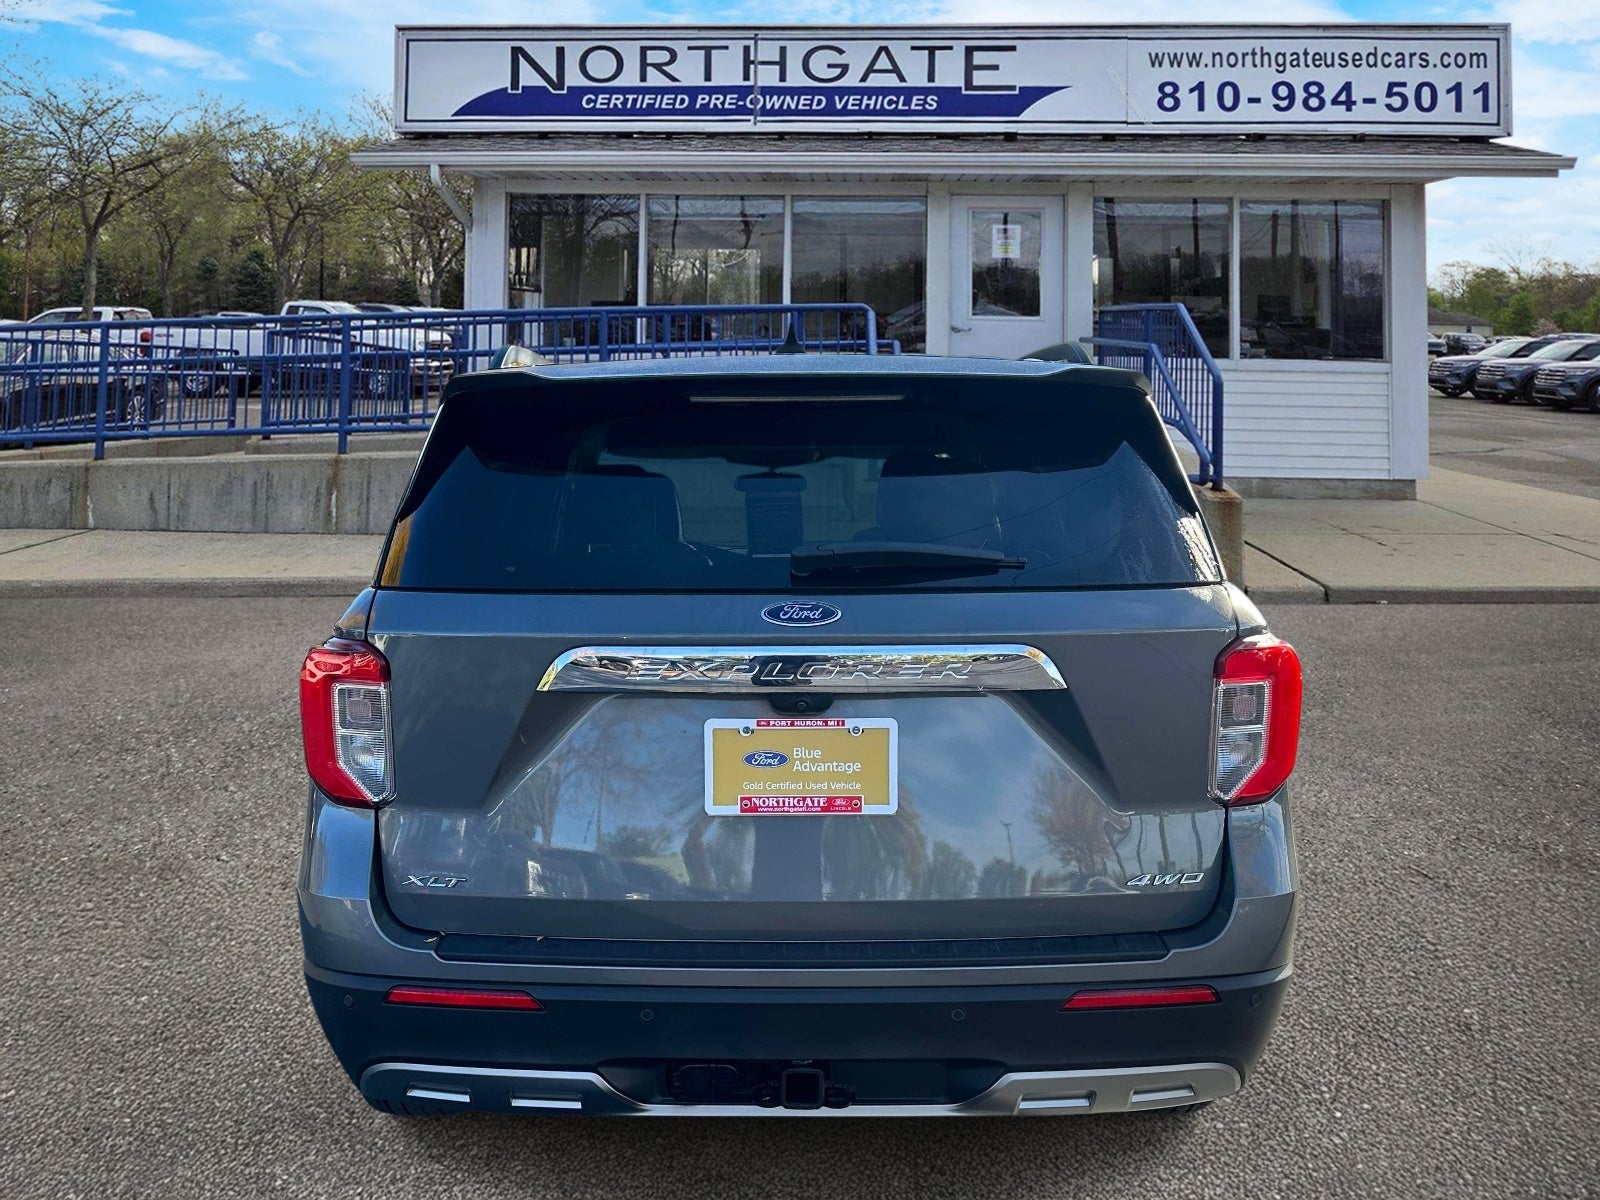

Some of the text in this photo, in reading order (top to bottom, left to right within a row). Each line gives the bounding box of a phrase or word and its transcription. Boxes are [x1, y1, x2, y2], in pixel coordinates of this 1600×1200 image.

[1149, 47, 1488, 73] www.northgateusedcars.com
[510, 45, 1017, 91] NORTHGATE
[581, 94, 938, 110] CERTIFIED PRE-OWNED VEHICLES
[1156, 80, 1491, 113] 810-984-5011
[779, 604, 823, 620] Ford
[625, 660, 973, 681] EXPLORER
[751, 752, 780, 765] Ford
[793, 747, 822, 759] Blue
[792, 760, 861, 774] Advantage
[742, 781, 861, 790] Gold Certified Used Vehicle
[751, 797, 828, 807] NORTHGATE
[401, 874, 467, 888] XLT
[1126, 872, 1205, 886] 4WD
